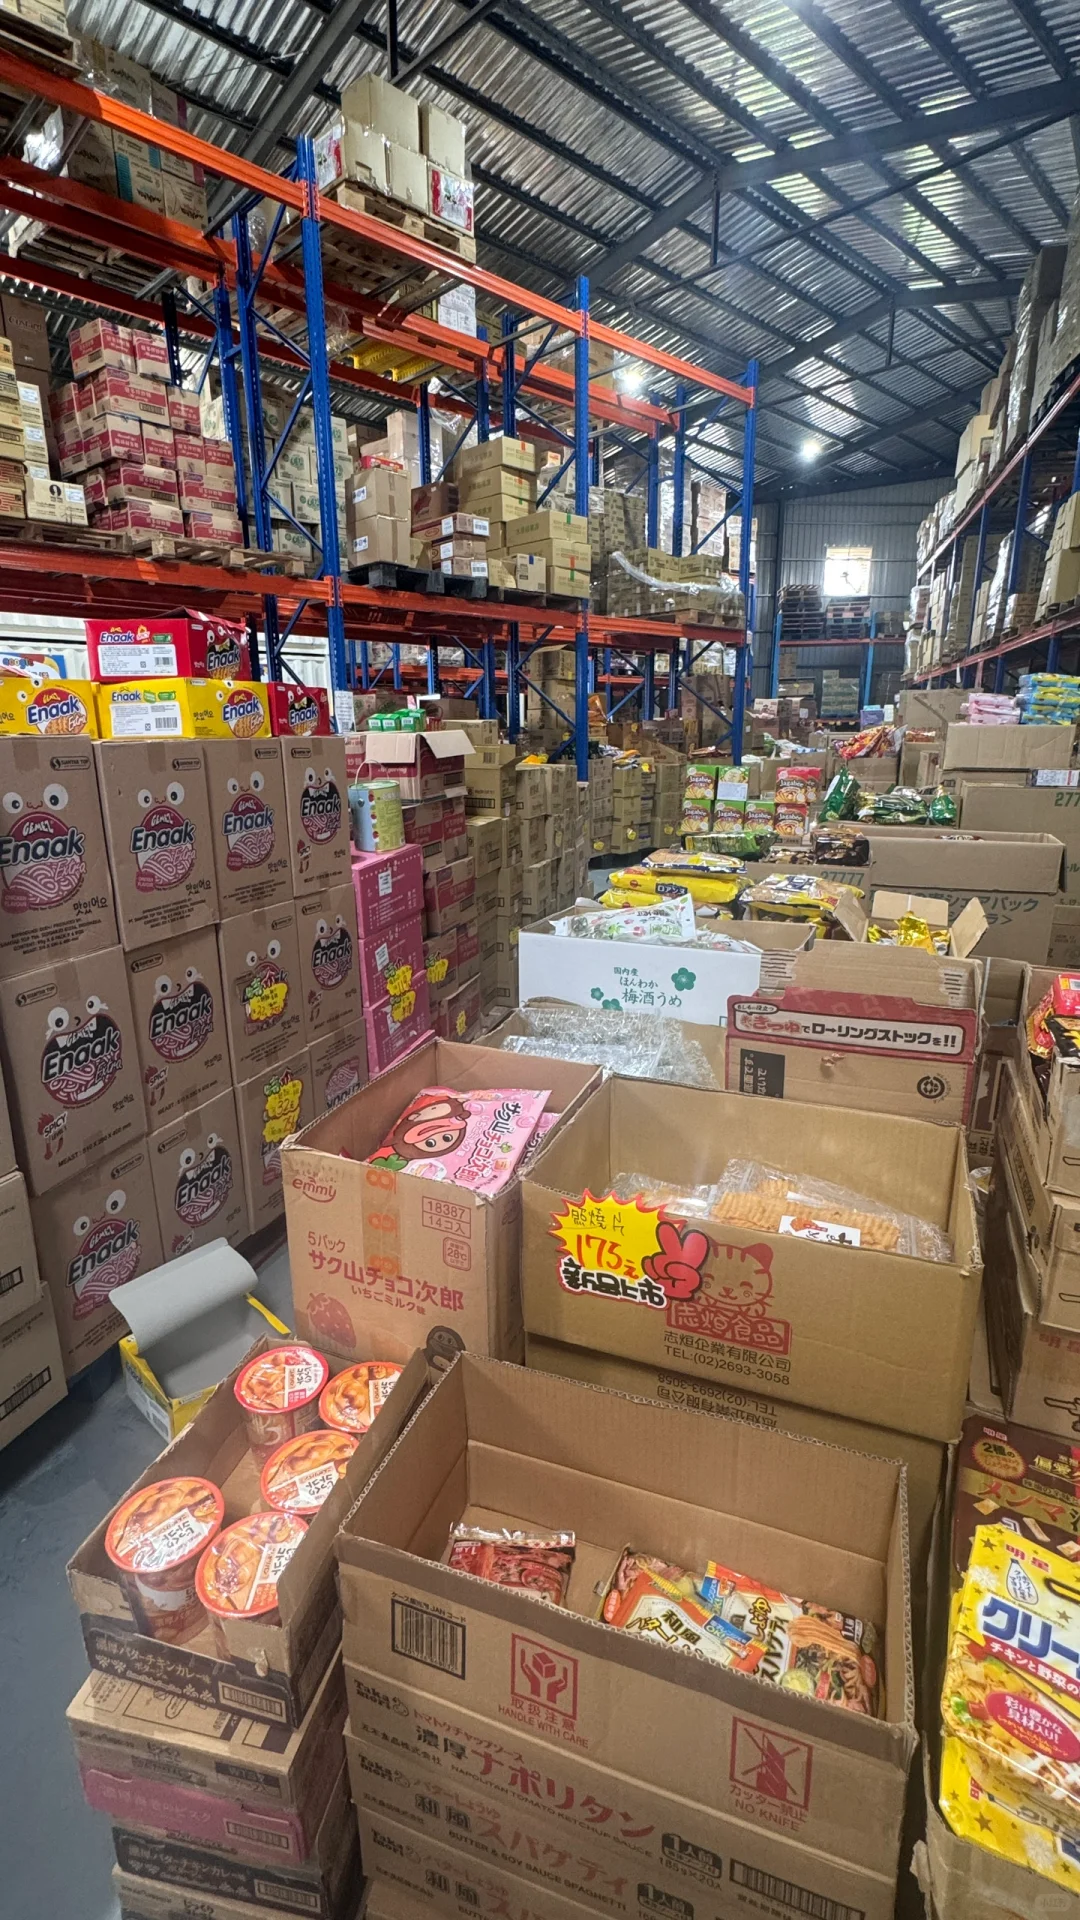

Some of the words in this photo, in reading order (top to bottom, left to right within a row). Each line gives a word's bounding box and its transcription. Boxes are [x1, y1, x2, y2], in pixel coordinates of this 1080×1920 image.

[100, 632, 134, 643] Enaak
[206, 649, 241, 670] Enaak
[27, 697, 80, 724] Enaak
[112, 690, 141, 701] Enaak
[222, 697, 260, 722] Enaak
[289, 705, 318, 725] Enaak
[151, 812, 174, 826] GEMEZ
[222, 804, 274, 835] Enaak
[301, 794, 341, 817] Enaak
[22, 820, 54, 837] GEMEZ
[131, 819, 196, 853] Enaak
[0, 827, 85, 866] Enaak
[54, 860, 87, 881] Extra
[73, 897, 108, 916] 맛있어요
[312, 941, 351, 968] Enaak
[613, 966, 639, 977] 国内産
[619, 976, 659, 989] ほんわか
[621, 988, 683, 1008] 梅酒うめ
[149, 995, 213, 1040] Enaak
[66, 1023, 95, 1046] GEMEZ
[42, 1026, 120, 1083] Enaak
[43, 1111, 68, 1138] SPICY
[452, 1101, 523, 1183] サク山チョコ次郎
[175, 1154, 231, 1211] Enaak
[427, 1200, 466, 1220] 18387
[428, 1215, 466, 1235] 14コ入
[66, 1219, 139, 1288] Enaak
[307, 1231, 346, 1254] 5パック
[308, 1249, 465, 1313] サク山チョコ次郎
[562, 1257, 667, 1308] 新品上市
[350, 1284, 427, 1316] いちごミルク味
[674, 1304, 782, 1349] 志烜食品
[664, 1330, 791, 1372] 志烜企業有限公司
[665, 1345, 790, 1386] TEL:(02)2693-3058
[296, 1367, 304, 1386] コトコト
[304, 1366, 313, 1383] じっくり
[380, 1381, 389, 1399] コトコト
[305, 1473, 333, 1489] コトコト
[308, 1480, 335, 1496] じっくり
[162, 1520, 191, 1542] コトコト
[167, 1526, 195, 1549] じっくり
[271, 1547, 286, 1576] コトコト
[1005, 1543, 1050, 1573] 明星
[430, 1604, 446, 1616] JAN
[446, 1611, 467, 1624] コード
[661, 1609, 702, 1645] 和風
[705, 1624, 726, 1638] OK!
[982, 1596, 1080, 1668] クリー
[990, 1641, 1080, 1696] チキンと野菜の
[498, 1703, 536, 1726] HANDLE
[537, 1719, 561, 1738] WITH
[562, 1728, 590, 1749] CARE
[511, 1694, 577, 1732] 取扱注意
[1004, 1694, 1064, 1735] 彩り豊かな
[413, 1708, 525, 1764] トマトケチャップソース
[415, 1725, 469, 1760] 濃厚
[470, 1748, 656, 1838] ナポリタン
[729, 1783, 808, 1824] カッター禁止
[415, 1793, 471, 1832] 和風
[450, 1764, 509, 1794] NAPOLITAN
[511, 1790, 556, 1815] TOMATO
[557, 1811, 611, 1838] KETCHUP
[612, 1835, 654, 1858] SAUCE
[734, 1798, 756, 1815] NO
[758, 1806, 801, 1833] KNIFE
[476, 1815, 628, 1895] スパゲティ
[673, 1834, 714, 1866] 1人前
[448, 1829, 489, 1852] BUTTER
[501, 1852, 523, 1867] SOY
[525, 1863, 562, 1884] SAUCE
[563, 1878, 627, 1912] SPAGHETTI
[424, 1867, 482, 1908] 和風
[645, 1883, 685, 1912] 1人前
